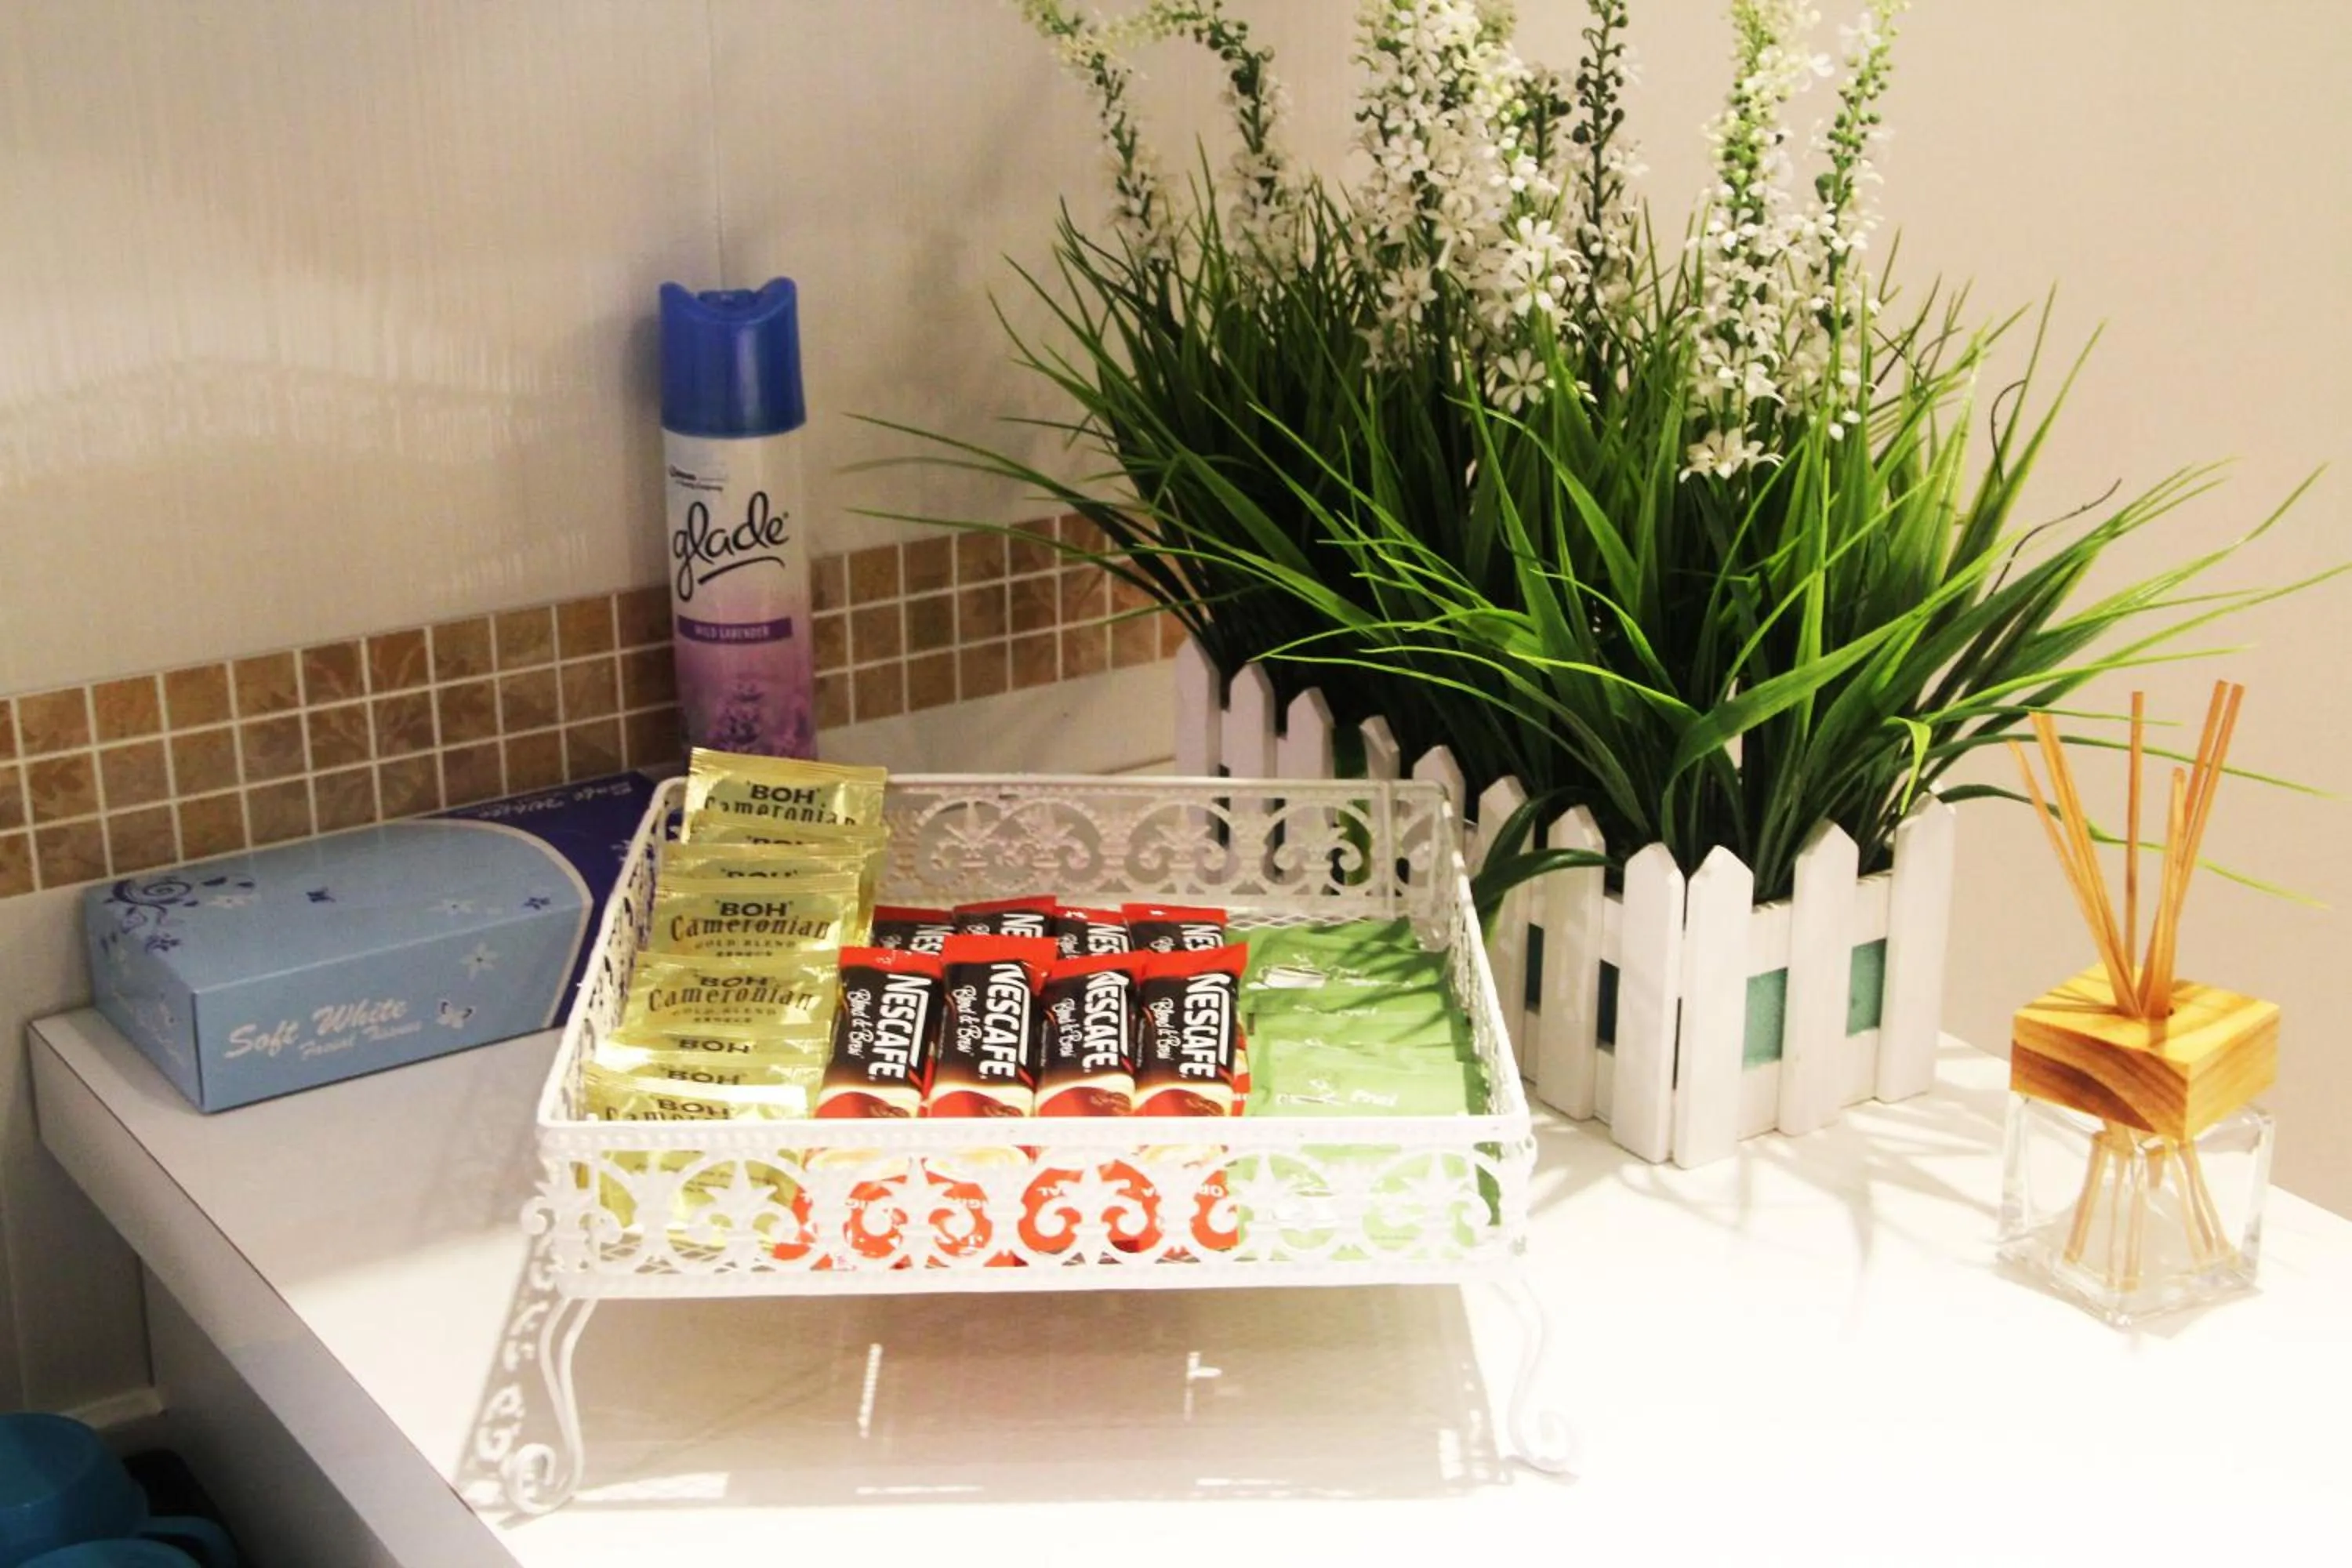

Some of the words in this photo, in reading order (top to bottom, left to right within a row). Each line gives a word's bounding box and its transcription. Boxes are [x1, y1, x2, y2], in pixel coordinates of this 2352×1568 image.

[673, 491, 789, 602] glade
[670, 914, 833, 942] Cameronian
[648, 985, 814, 1012] Cameronian
[223, 1019, 300, 1058] Soft
[311, 997, 408, 1036] White
